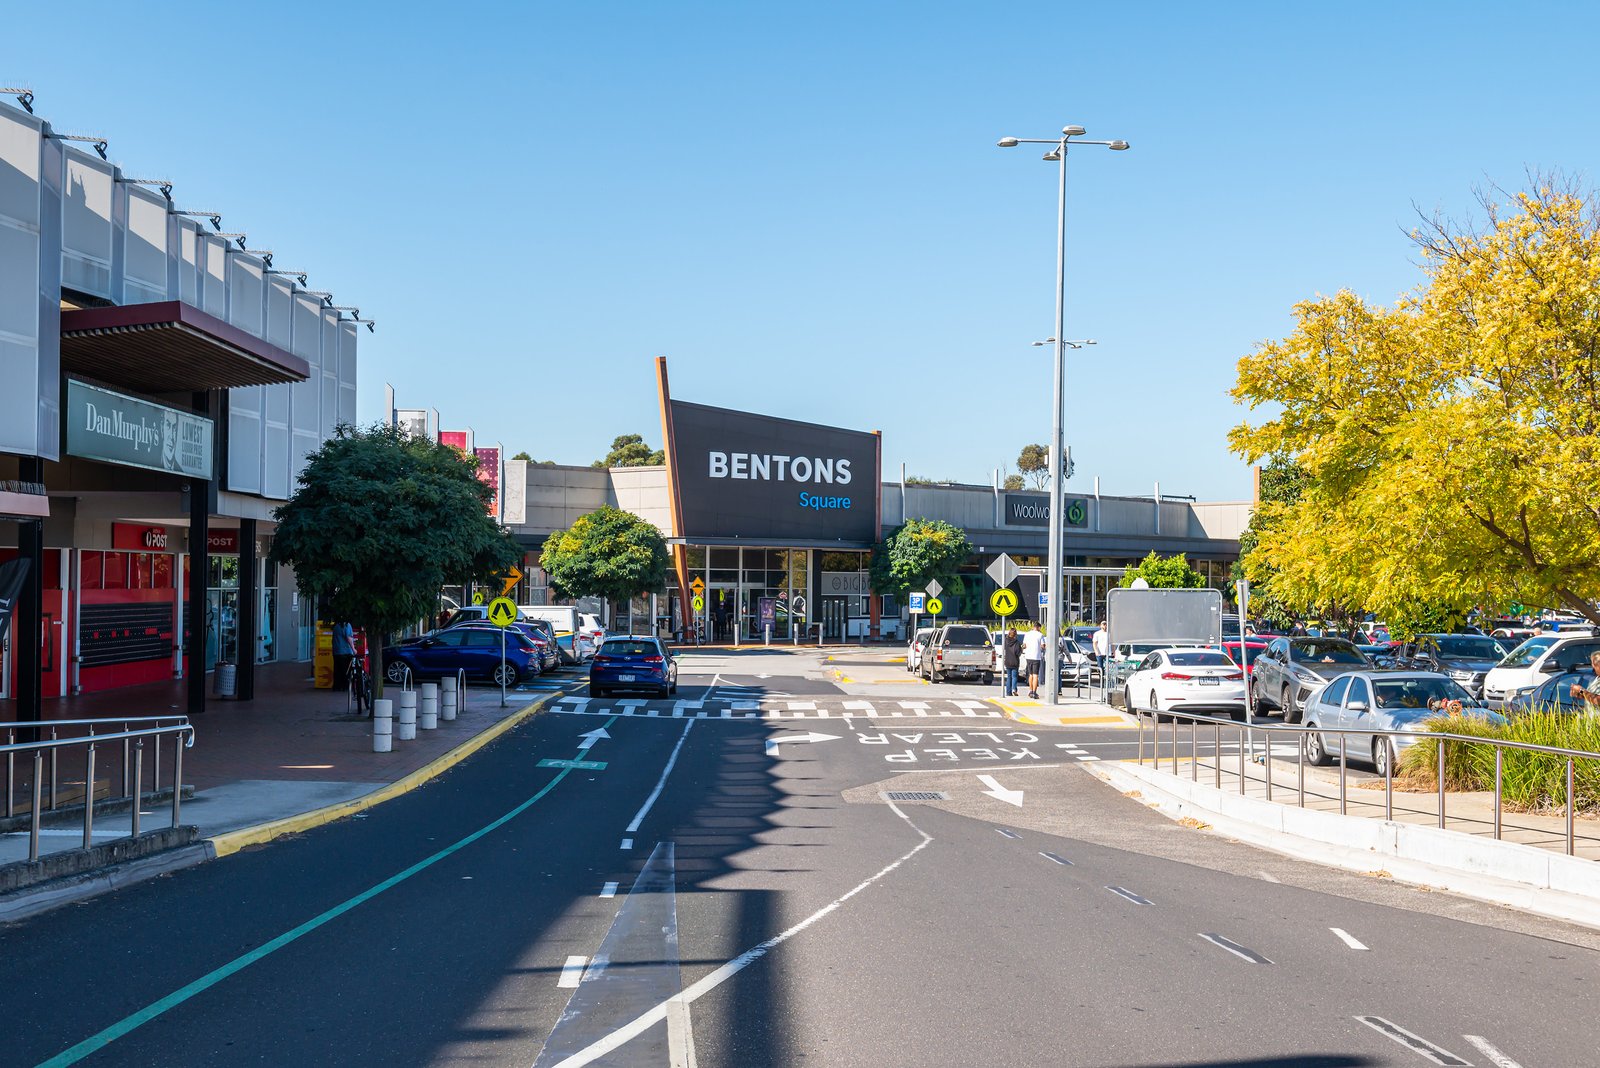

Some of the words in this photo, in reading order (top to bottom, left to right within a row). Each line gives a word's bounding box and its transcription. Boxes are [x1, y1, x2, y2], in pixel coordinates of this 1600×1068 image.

[86, 402, 111, 434] Dan
[112, 409, 159, 453] Murphy's
[182, 421, 203, 444] LOWEST
[708, 451, 852, 485] BENTONS
[799, 491, 851, 510] Square
[152, 534, 168, 548] POST
[856, 732, 1039, 745] CLEAR
[884, 747, 1041, 763] KEEP
